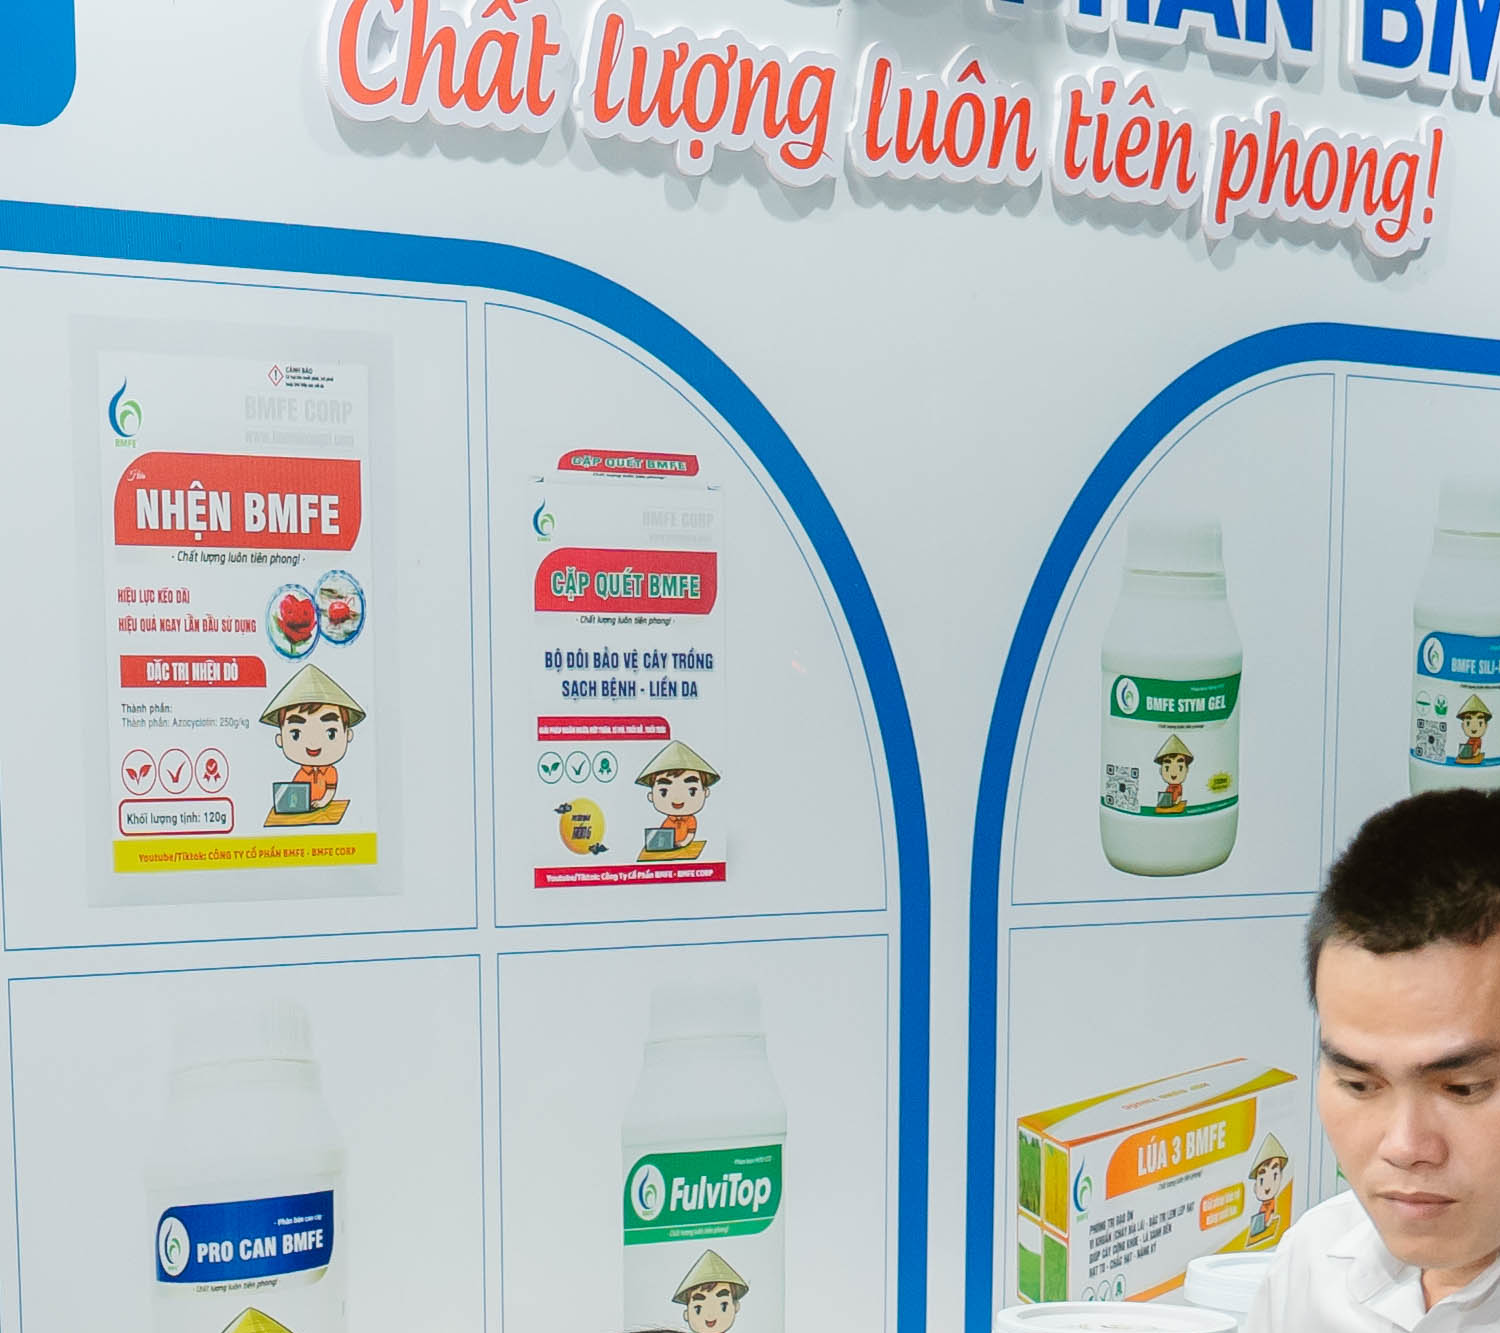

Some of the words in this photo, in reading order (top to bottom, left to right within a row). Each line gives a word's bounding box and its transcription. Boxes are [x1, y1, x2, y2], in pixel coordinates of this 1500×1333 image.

[338, 0, 560, 116] Chất
[591, 13, 835, 170] lượng
[864, 58, 1037, 172] luôn
[1064, 80, 1197, 194] tiên
[1214, 111, 1443, 242] phong!
[136, 480, 231, 541] NHỆN
[244, 492, 340, 535] BMFE
[551, 566, 590, 600] CẶP
[595, 567, 643, 599] QUÉT
[648, 575, 700, 598] BMFE
[593, 647, 619, 669] BẢO
[643, 650, 667, 669] CÂY
[1146, 696, 1174, 712] BMFE
[1208, 695, 1226, 711] GEL
[127, 812, 148, 826] Khối
[151, 812, 177, 828] lượng
[204, 812, 227, 826] 120g
[1137, 1136, 1168, 1178] LÚA
[1172, 1135, 1181, 1163] 3
[1185, 1120, 1226, 1160] BMFE
[669, 1171, 772, 1212] FulviTop
[197, 1241, 233, 1263] PRO
[239, 1236, 277, 1260] CAN
[282, 1229, 323, 1254] BMFE
